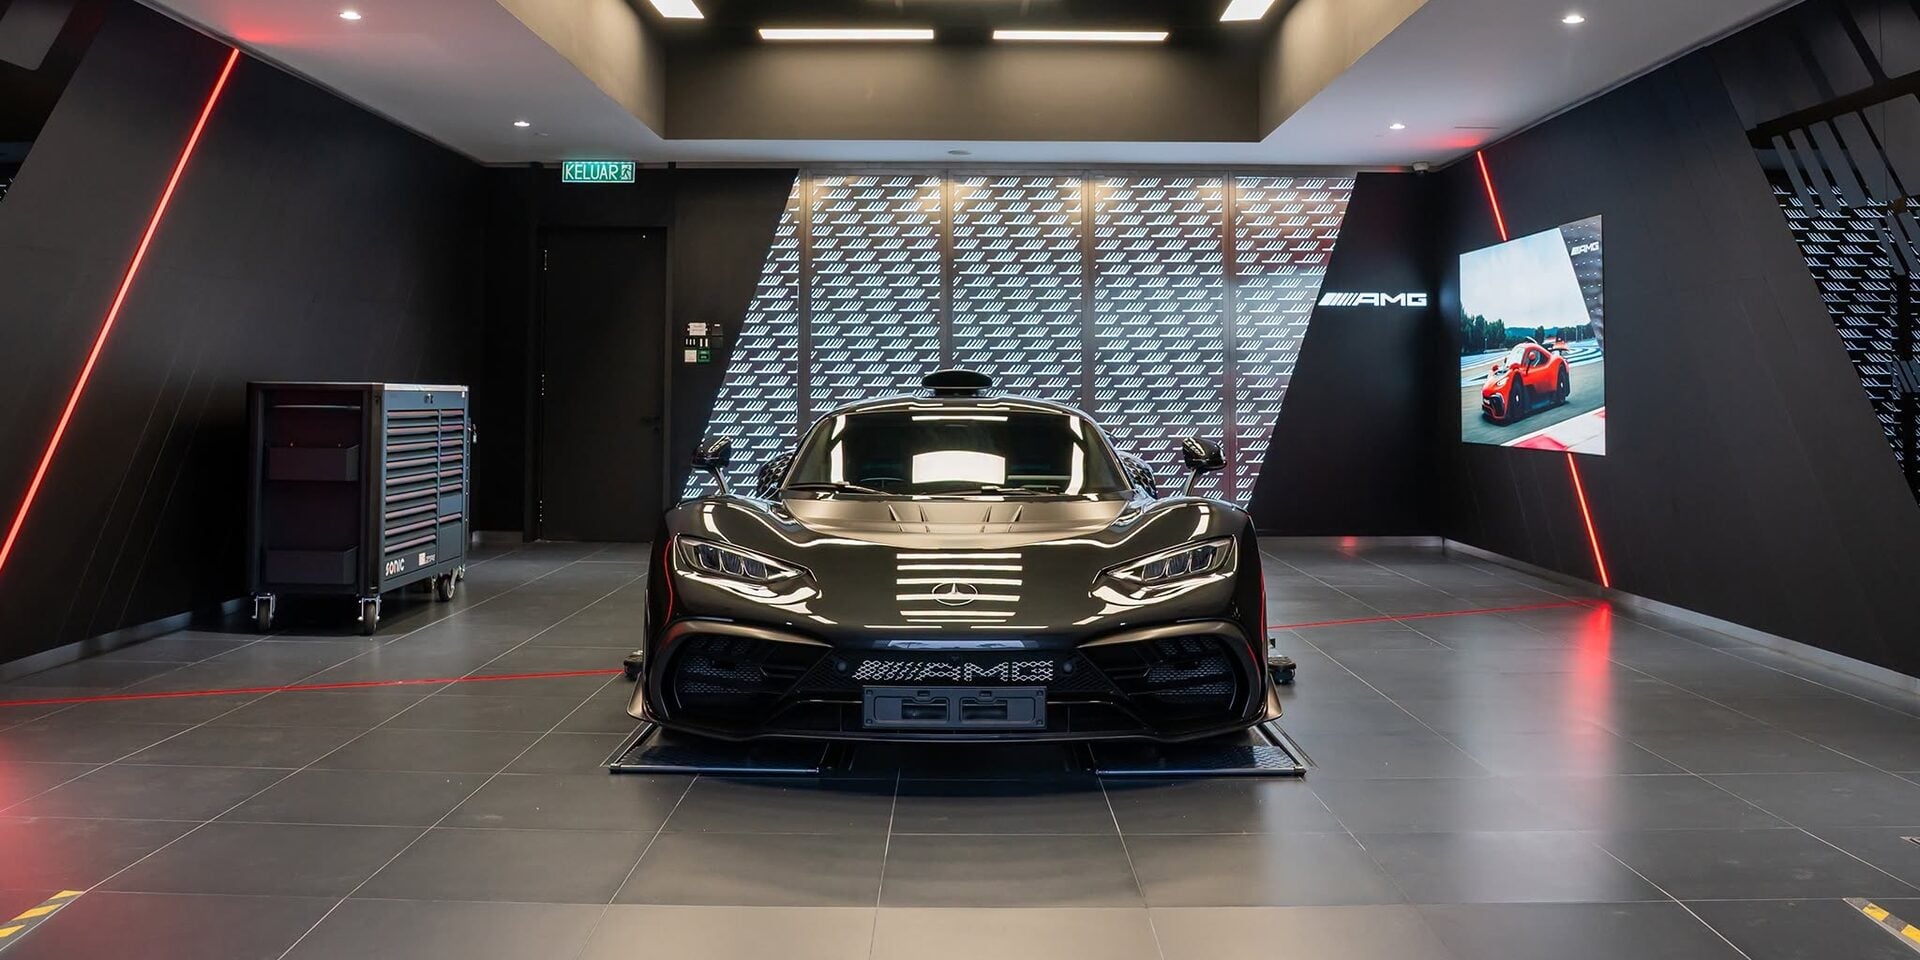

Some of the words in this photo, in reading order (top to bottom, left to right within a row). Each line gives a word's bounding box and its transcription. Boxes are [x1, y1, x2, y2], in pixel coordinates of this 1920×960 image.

[565, 165, 618, 180] KELUAR
[1352, 293, 1427, 306] AMG
[914, 661, 1053, 681] AMG
